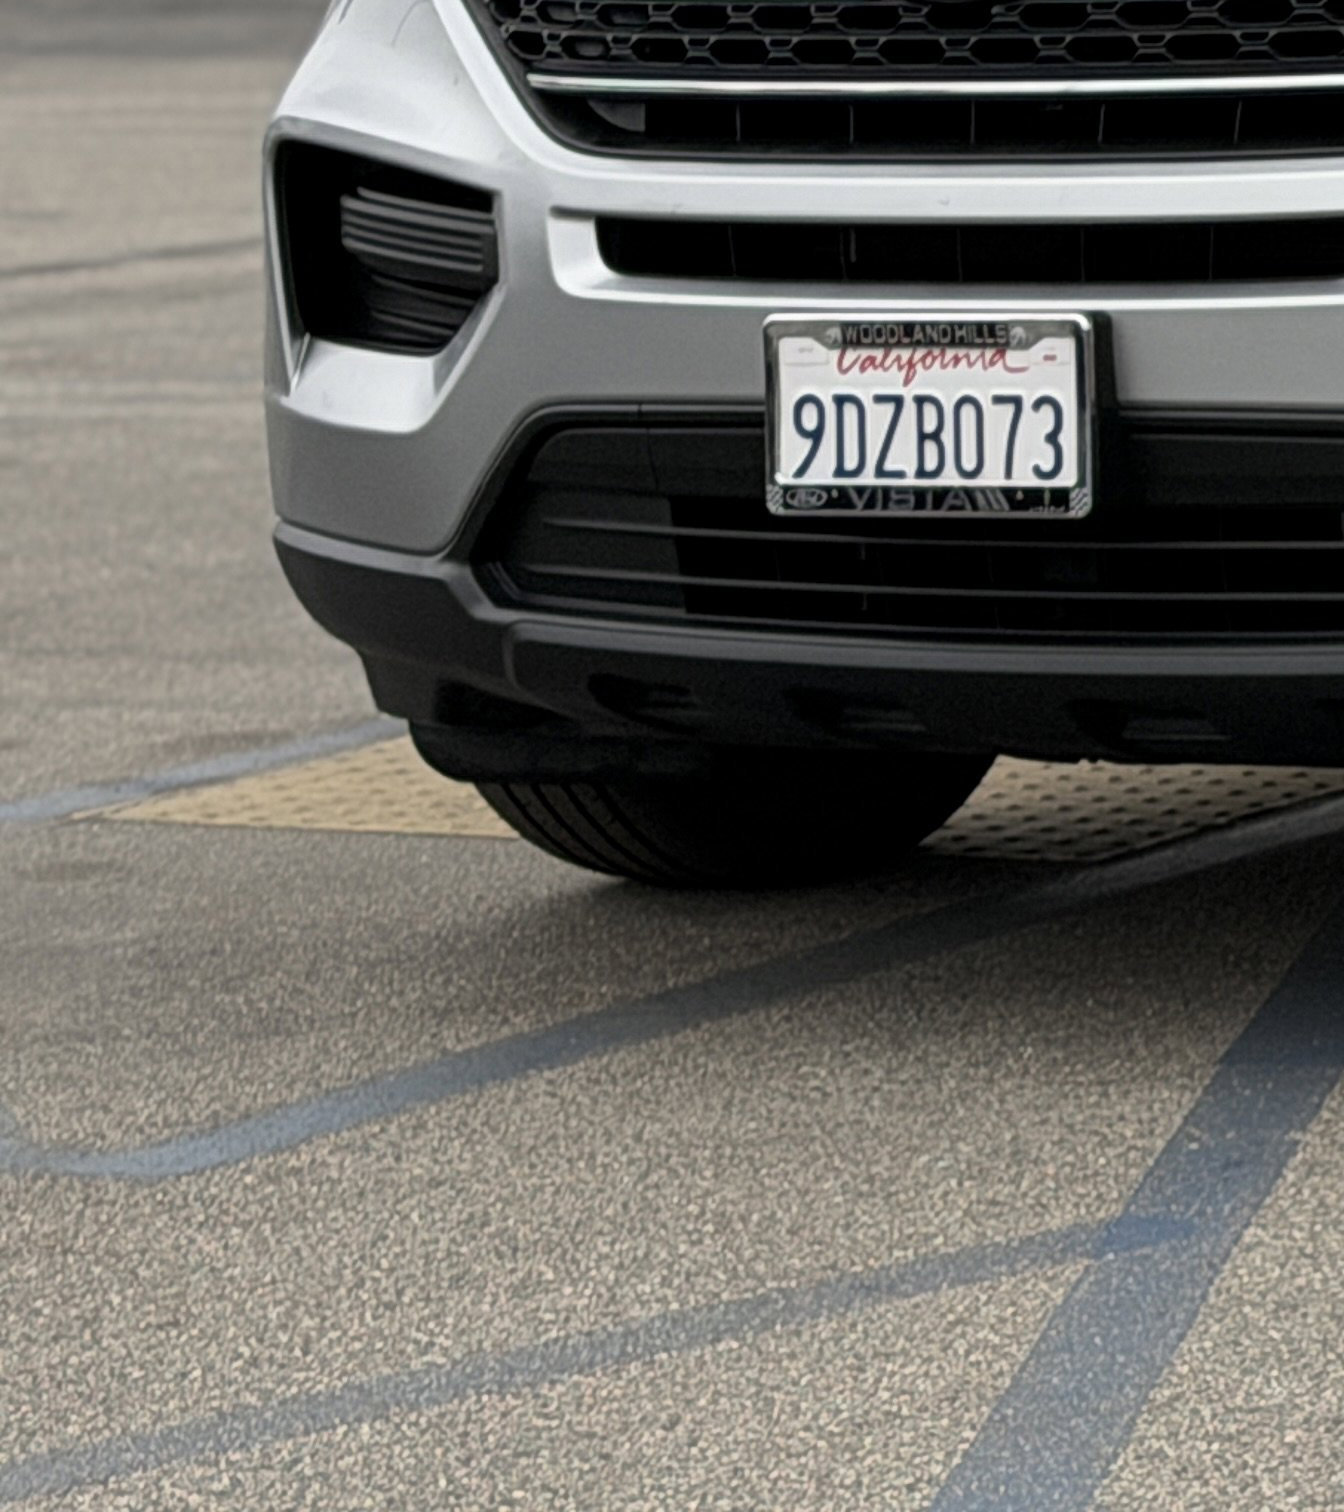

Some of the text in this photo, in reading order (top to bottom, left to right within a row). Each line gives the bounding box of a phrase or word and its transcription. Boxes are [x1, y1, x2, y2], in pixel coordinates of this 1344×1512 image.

[843, 324, 1008, 345] WOODLAND HILLS
[837, 346, 1030, 388] California
[791, 393, 1064, 481] 9DZB073
[849, 488, 973, 512] VISTA
